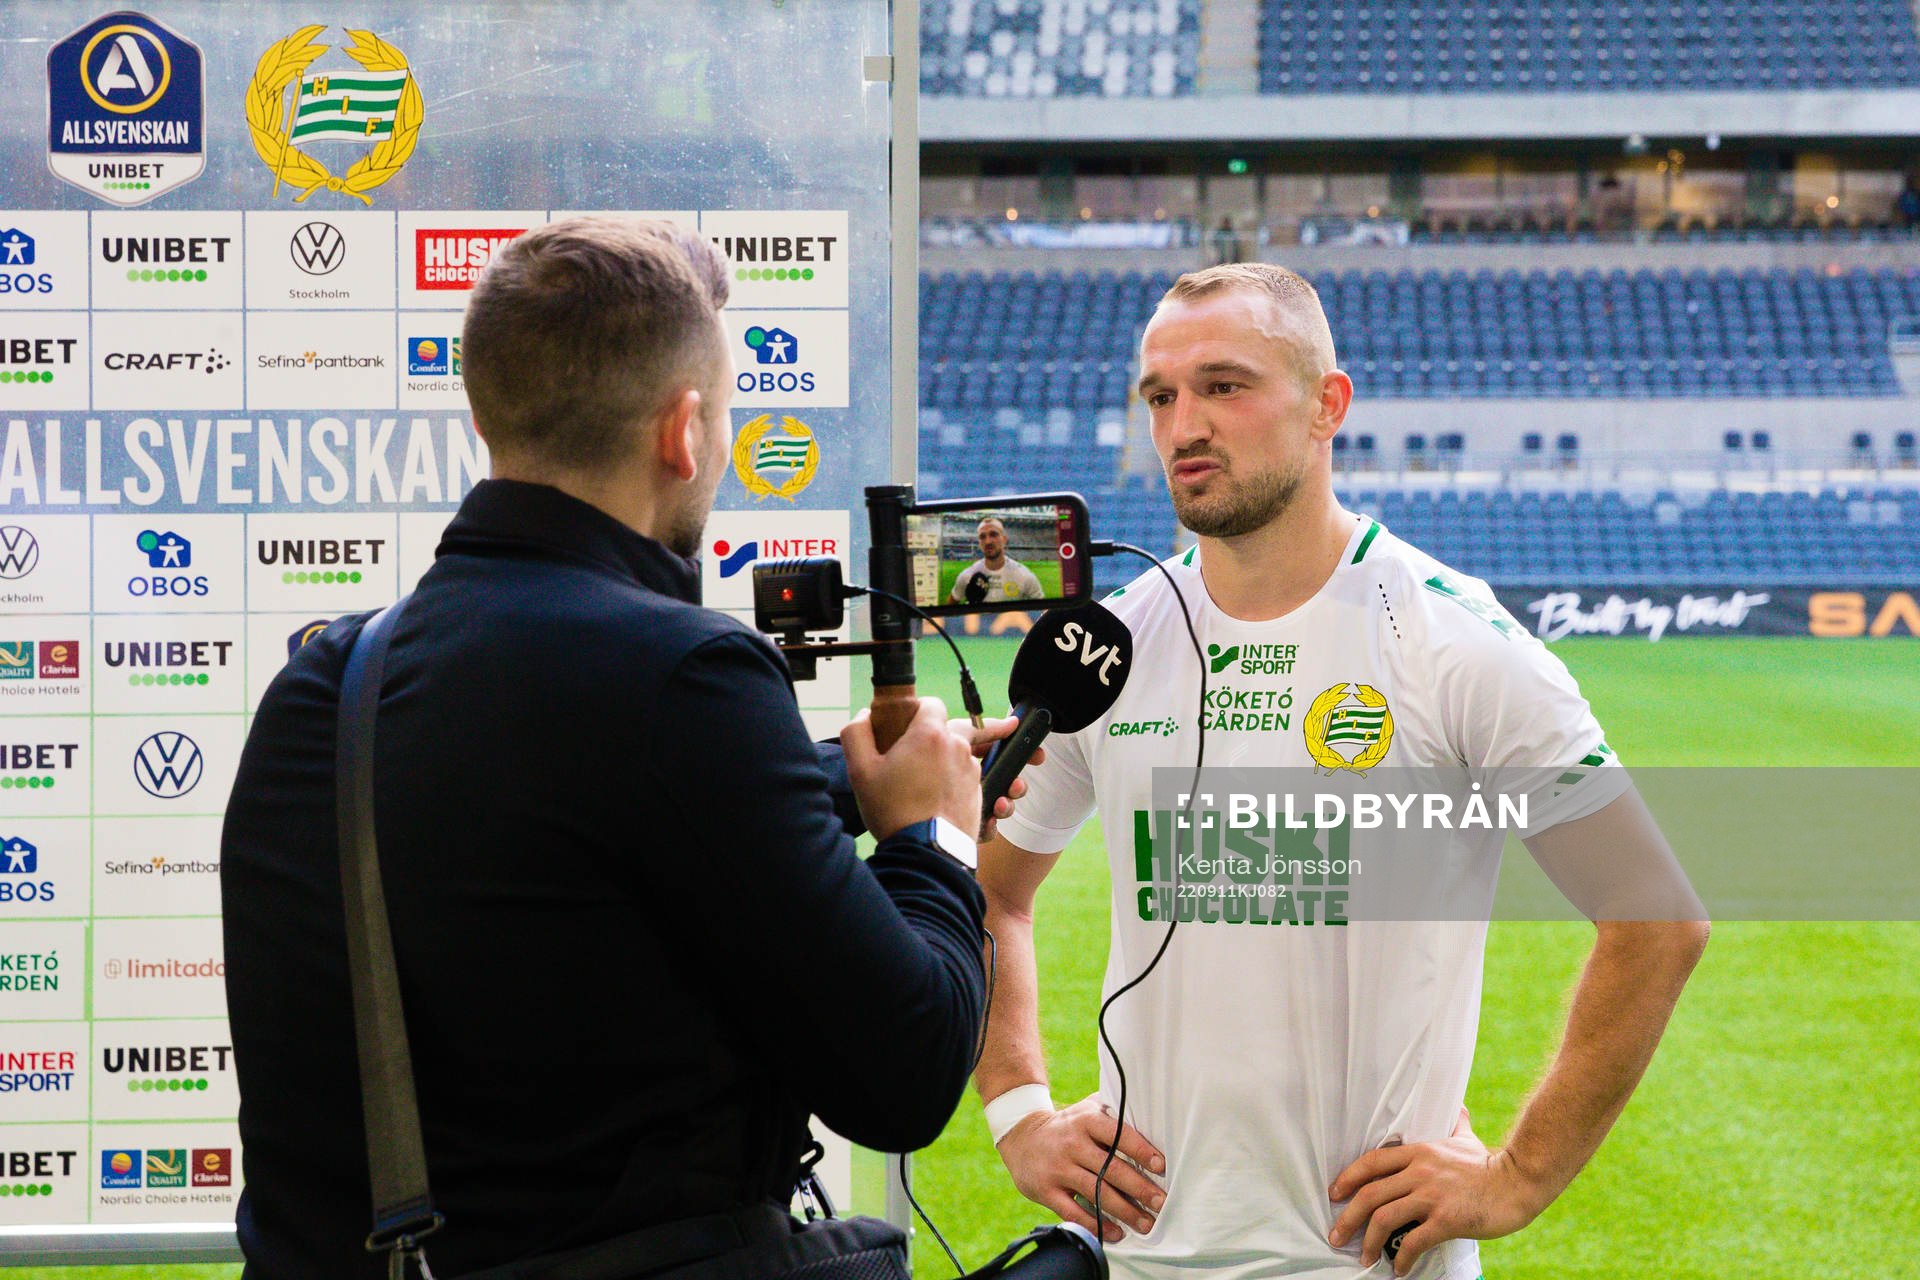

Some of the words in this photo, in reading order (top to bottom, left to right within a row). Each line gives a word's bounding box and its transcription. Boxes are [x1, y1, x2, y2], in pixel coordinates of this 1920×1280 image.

[62, 120, 189, 145] ALLSVENSKAN
[88, 163, 164, 179] UNIBET
[103, 237, 230, 262] UNIBET
[0, 274, 53, 293] BOS
[425, 268, 481, 282] CHOCO
[289, 289, 350, 299] Stockholm
[0, 339, 77, 364] IBET
[104, 353, 203, 371] CRAFT
[258, 355, 305, 368] Sefina
[314, 355, 384, 370] pantbank
[410, 363, 447, 373] Comfort
[408, 381, 448, 392] Nordic
[737, 372, 815, 392] OBOS
[0, 418, 490, 505] ALLSVENSKAN
[258, 539, 385, 565] UNIBET
[764, 539, 837, 557] INTER
[128, 576, 209, 597] OBOS
[0, 593, 44, 603] ckholm
[104, 641, 233, 667] UNIBET
[1054, 622, 1122, 686] svt
[1243, 644, 1296, 659] INTER
[1240, 660, 1295, 675] SPORT
[1, 685, 35, 695] hoice
[39, 685, 80, 695] Hotels
[1109, 721, 1163, 737] CRAFT
[1198, 711, 1290, 732] GÅRDEN
[0, 744, 78, 769] IBET
[1134, 810, 1350, 886] HUSKI
[105, 861, 153, 875] Sefina
[0, 882, 55, 902] BOS
[1136, 886, 1349, 926] CHOCOLATE
[1, 950, 58, 971] KETÓ
[0, 975, 58, 991] RDEN
[0, 1052, 75, 1071] INTER
[104, 1046, 232, 1073] UNIBET
[0, 1073, 74, 1092] SPORT
[0, 1151, 77, 1177] IBET
[100, 1194, 142, 1205] Nordic
[145, 1194, 187, 1204] Choice
[191, 1193, 232, 1203] Hotels
